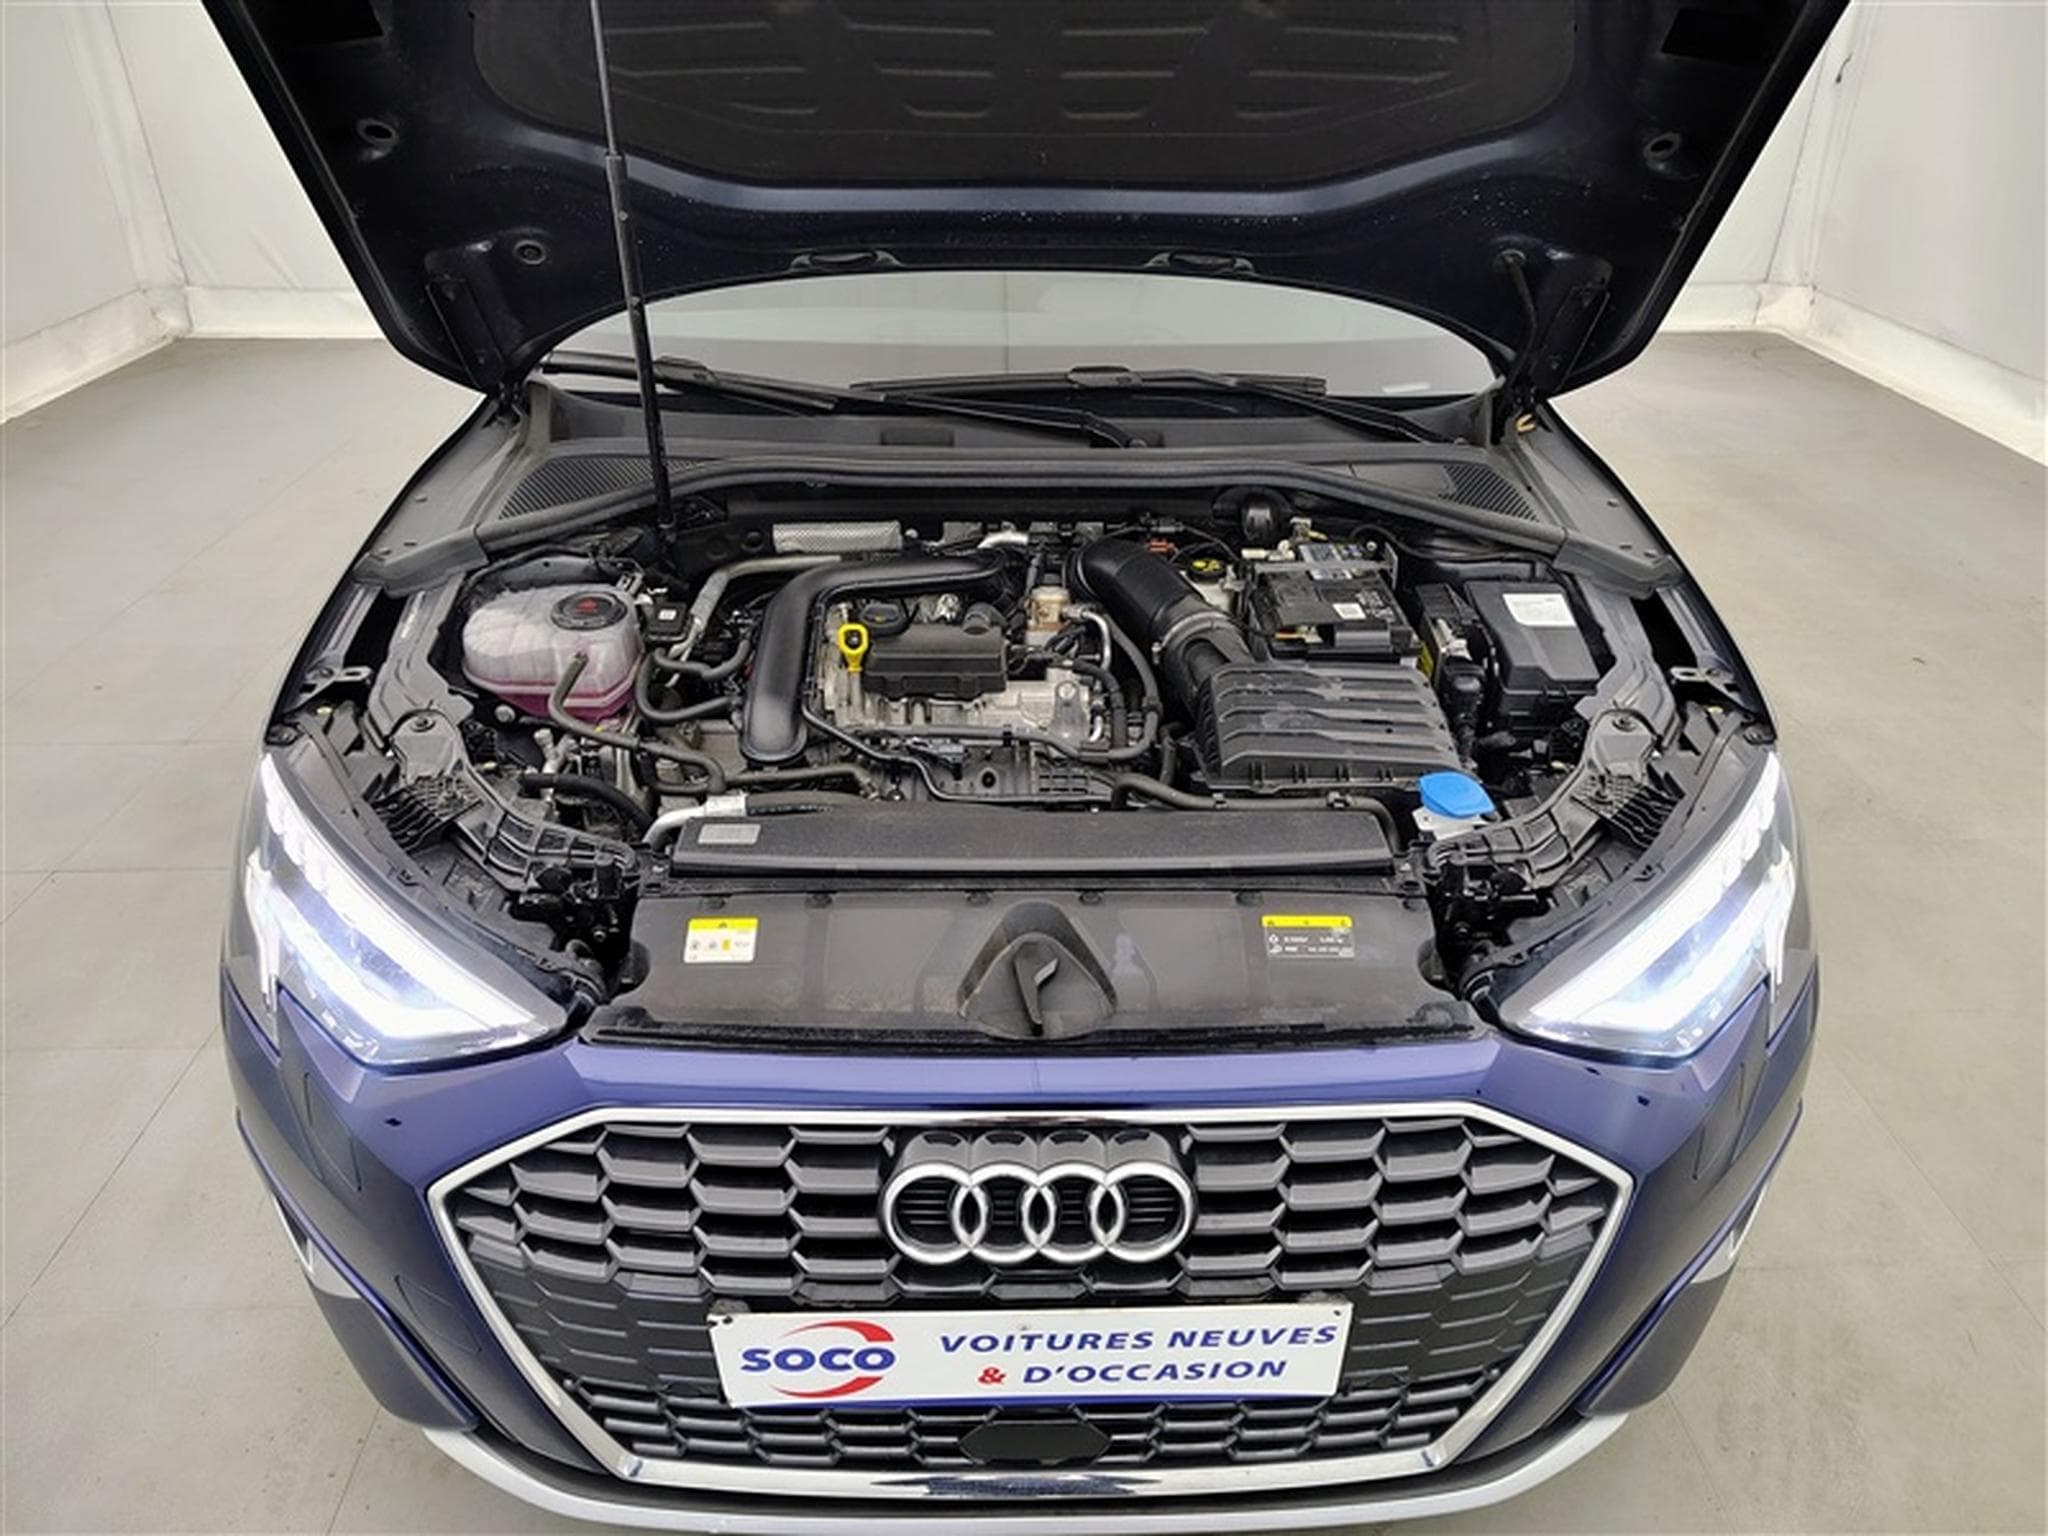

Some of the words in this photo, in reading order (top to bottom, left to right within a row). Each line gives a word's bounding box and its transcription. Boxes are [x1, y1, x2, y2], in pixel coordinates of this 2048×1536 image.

[940, 1331, 1155, 1353] VOITURES
[1168, 1326, 1338, 1348] NEUVES
[741, 1347, 897, 1373] SOCO
[978, 1366, 1007, 1385] &
[1024, 1359, 1288, 1384] D'OCCASION
